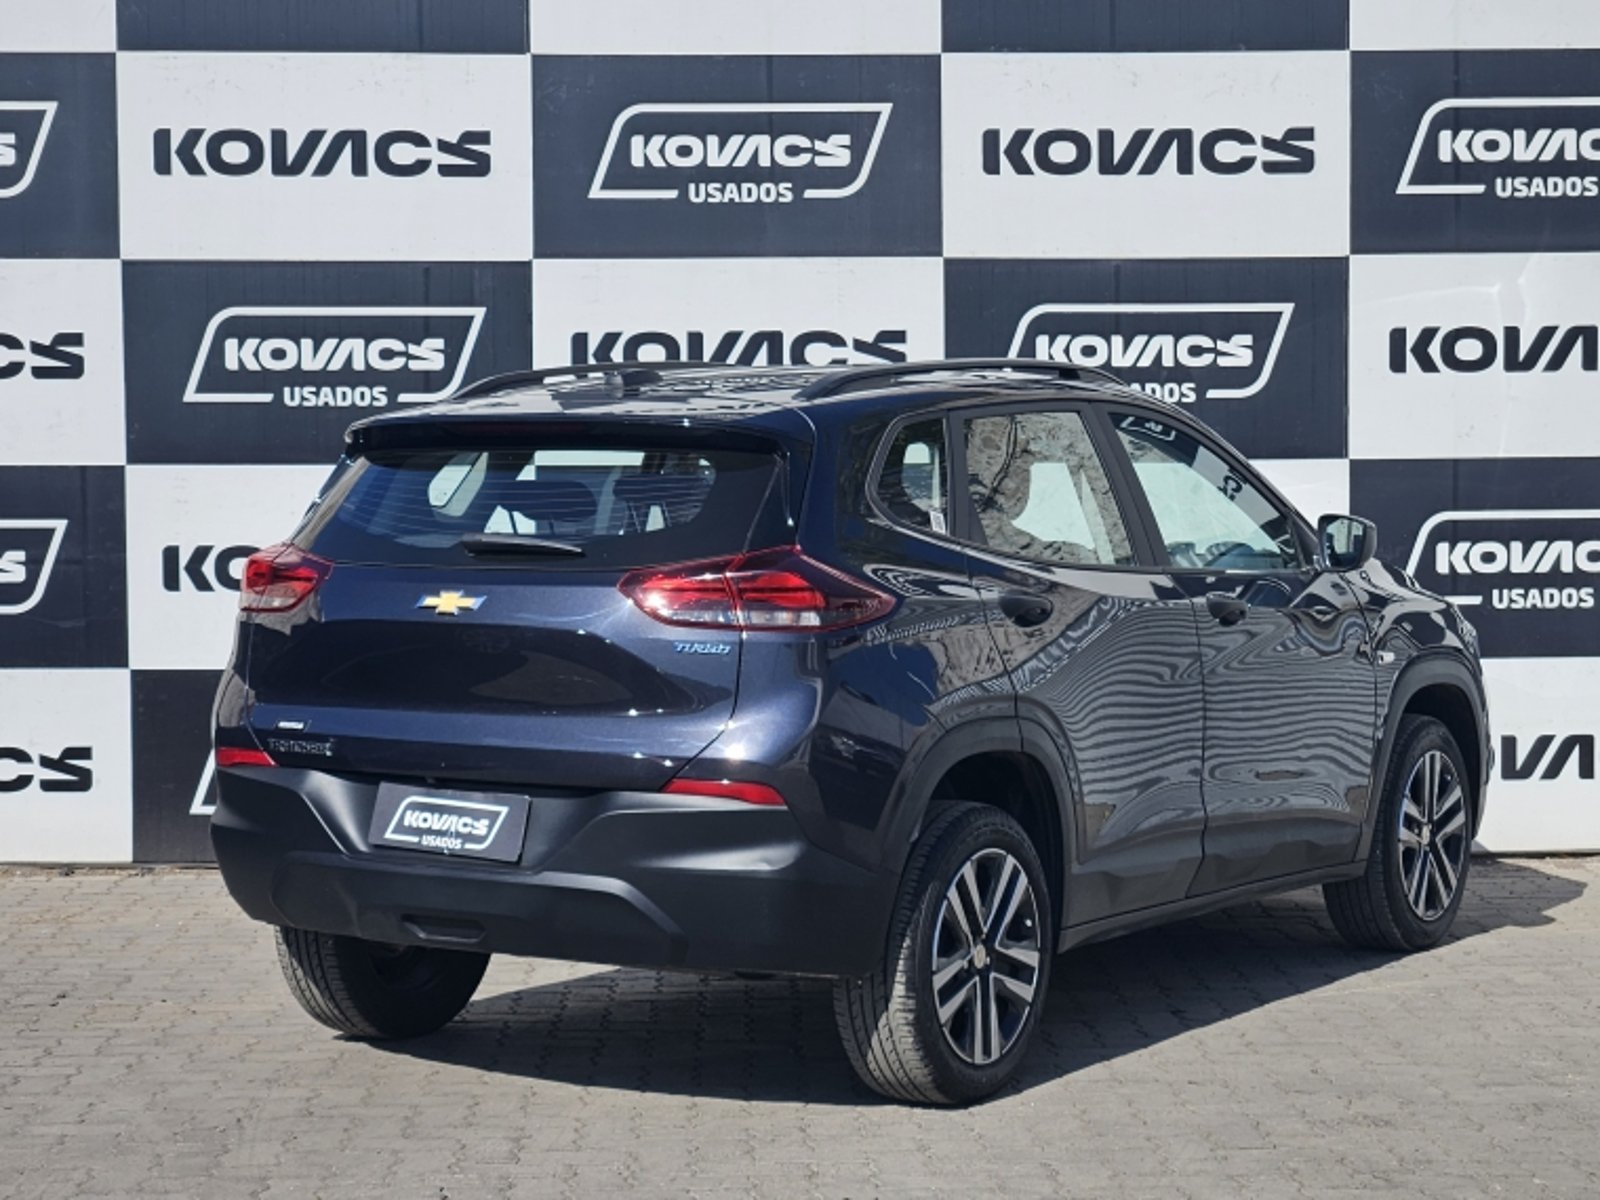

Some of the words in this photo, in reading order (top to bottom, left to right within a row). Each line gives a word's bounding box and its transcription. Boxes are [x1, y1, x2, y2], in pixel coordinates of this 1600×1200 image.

[154, 128, 491, 177] KOVACS
[631, 135, 850, 167] KOVACS
[983, 127, 1314, 175] KOVACS
[1438, 129, 1600, 162] KOVAC
[688, 182, 793, 203] USADOS
[1495, 177, 1598, 197] USADOS
[225, 338, 444, 371] KOVACS
[1035, 334, 1253, 367] KOVACS
[1389, 325, 1598, 373] KOVA
[284, 387, 387, 407] USADOS
[1435, 541, 1600, 574] KOVAC
[1492, 587, 1595, 609] USADOS
[403, 810, 490, 836] KOVACS
